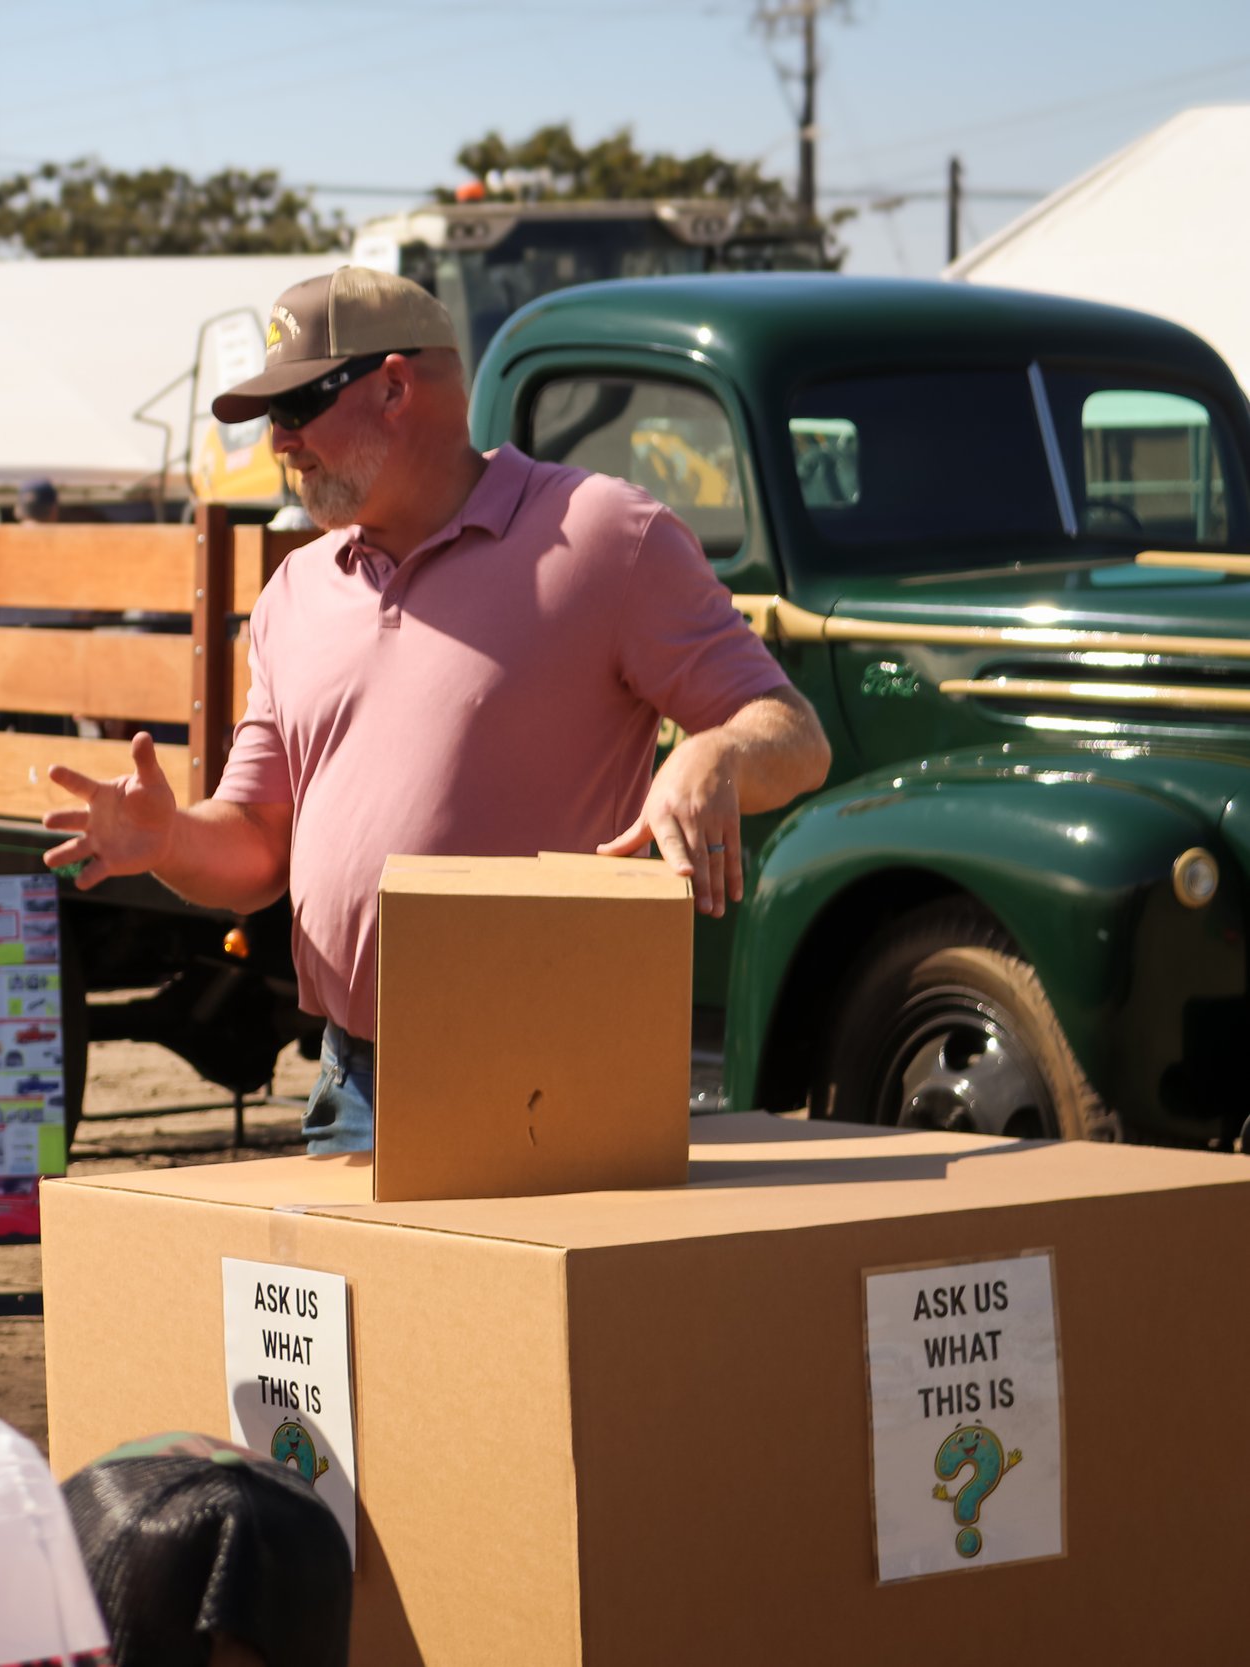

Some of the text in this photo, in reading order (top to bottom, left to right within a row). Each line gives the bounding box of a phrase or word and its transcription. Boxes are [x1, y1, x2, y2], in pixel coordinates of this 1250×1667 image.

[254, 1282, 318, 1320] ASK US
[913, 1281, 1009, 1321] ASK US
[262, 1329, 313, 1366] WHAT
[924, 1330, 1002, 1368] WHAT
[257, 1375, 322, 1415] THIS IS
[918, 1378, 1015, 1418] THIS IS
